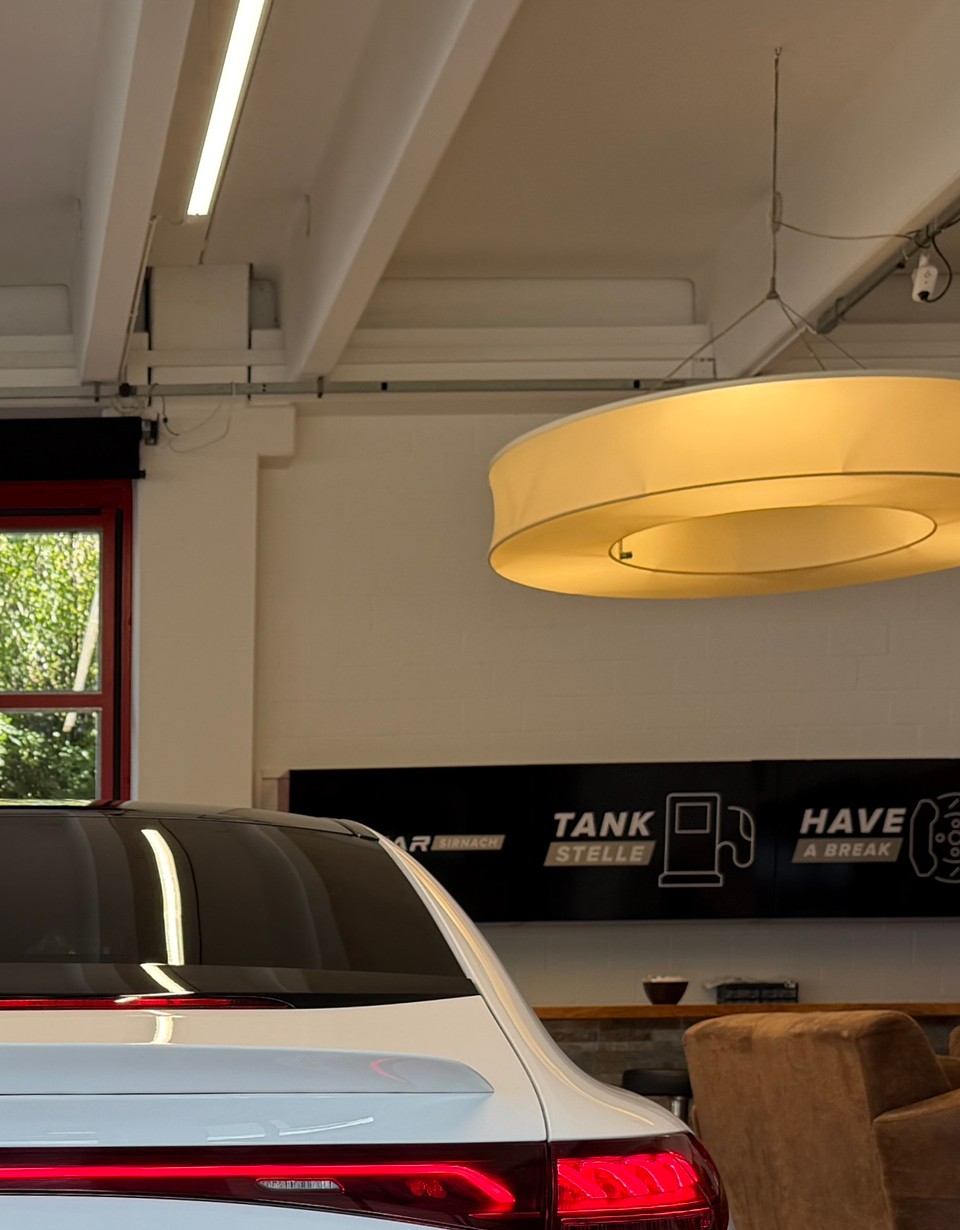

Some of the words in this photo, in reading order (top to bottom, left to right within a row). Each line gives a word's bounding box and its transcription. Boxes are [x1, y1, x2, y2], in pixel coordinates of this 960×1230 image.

[553, 811, 656, 838] TANK
[799, 807, 907, 834] HAVE
[386, 835, 431, 852] AR
[439, 838, 499, 849] SIRNACH
[803, 844, 817, 857] A
[824, 843, 892, 857] BREAK
[555, 845, 646, 863] STELLE
